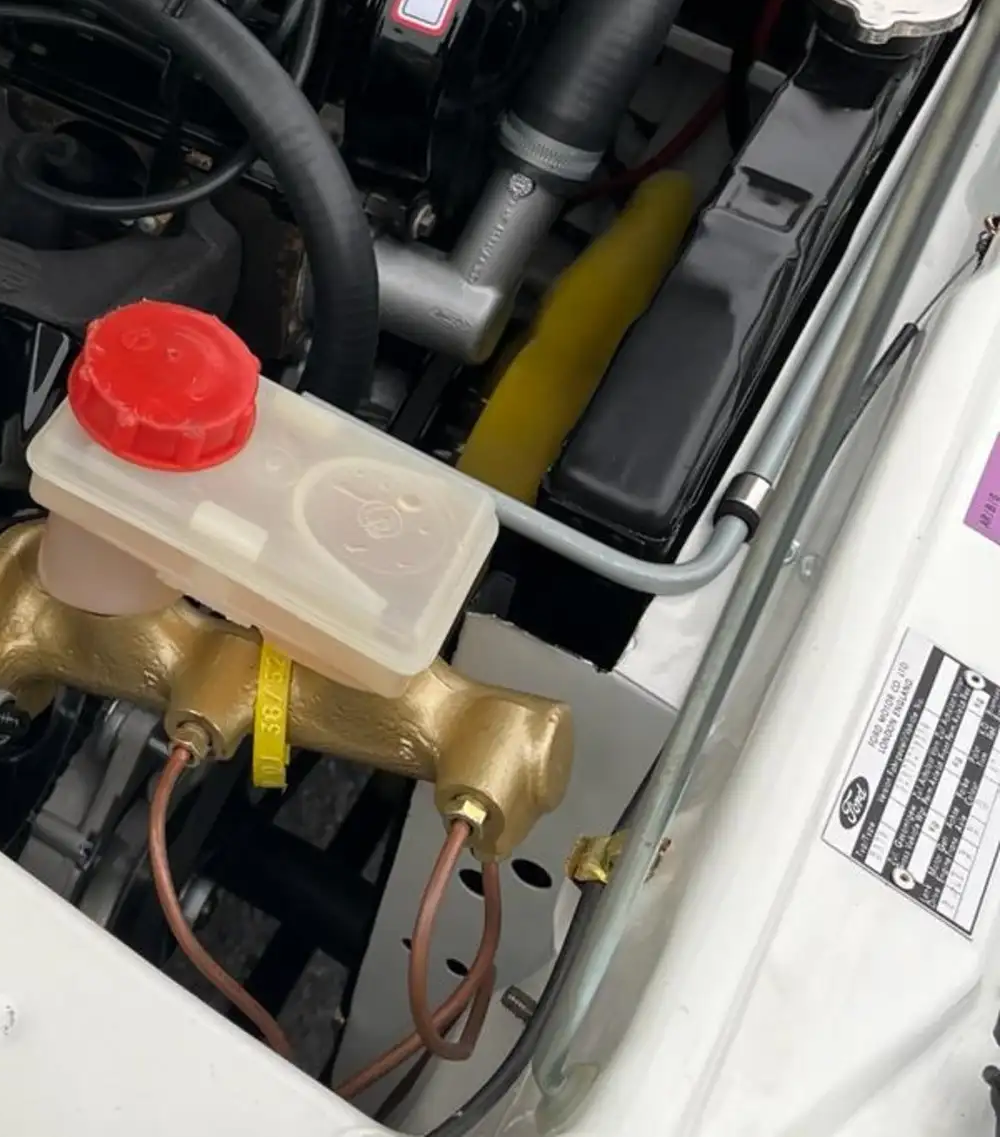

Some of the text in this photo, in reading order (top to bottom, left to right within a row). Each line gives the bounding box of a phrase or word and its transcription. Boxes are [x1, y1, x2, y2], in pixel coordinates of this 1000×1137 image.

[868, 723, 881, 747] FORD
[878, 691, 894, 723] MOTOR
[877, 677, 912, 755] LONDON ENGLAND
[841, 779, 868, 826] Ford
